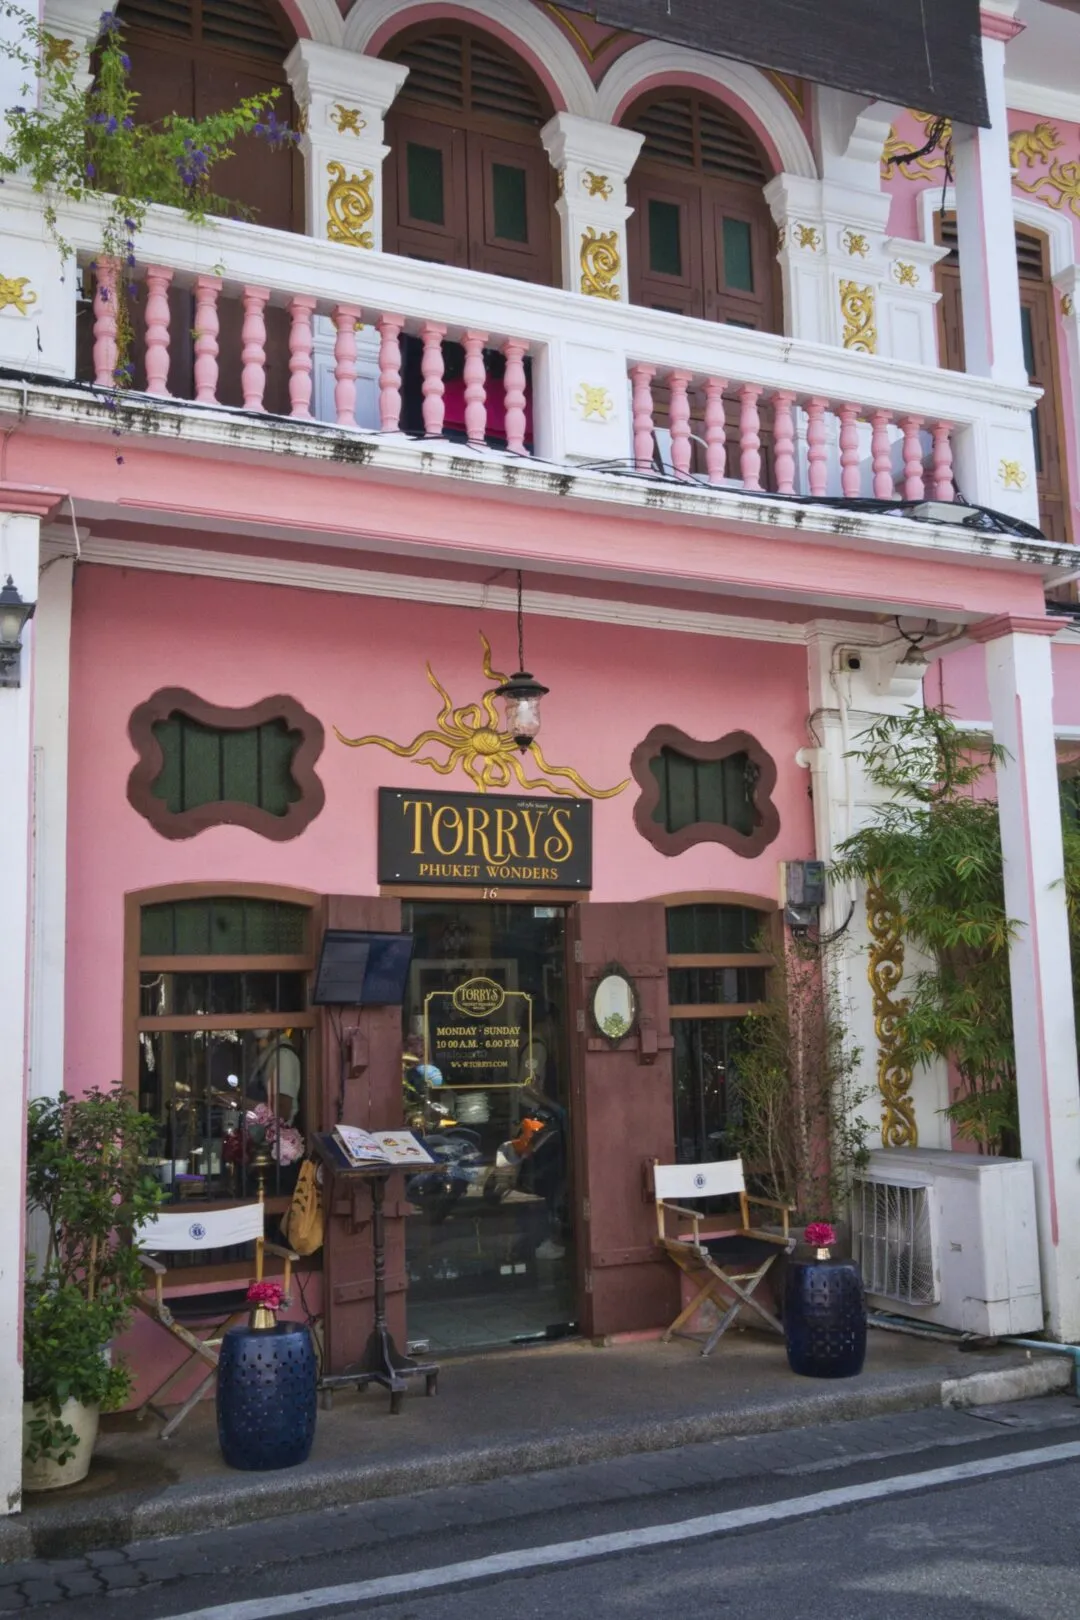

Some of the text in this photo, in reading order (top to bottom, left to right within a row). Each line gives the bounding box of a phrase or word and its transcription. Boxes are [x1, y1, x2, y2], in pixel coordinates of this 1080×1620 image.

[403, 801, 573, 865] TORRY'S
[419, 863, 559, 880] PHUKET WONDERS
[482, 887, 499, 899] 16
[436, 1026, 477, 1036] MONDAY
[483, 1026, 520, 1035] SUNDAY
